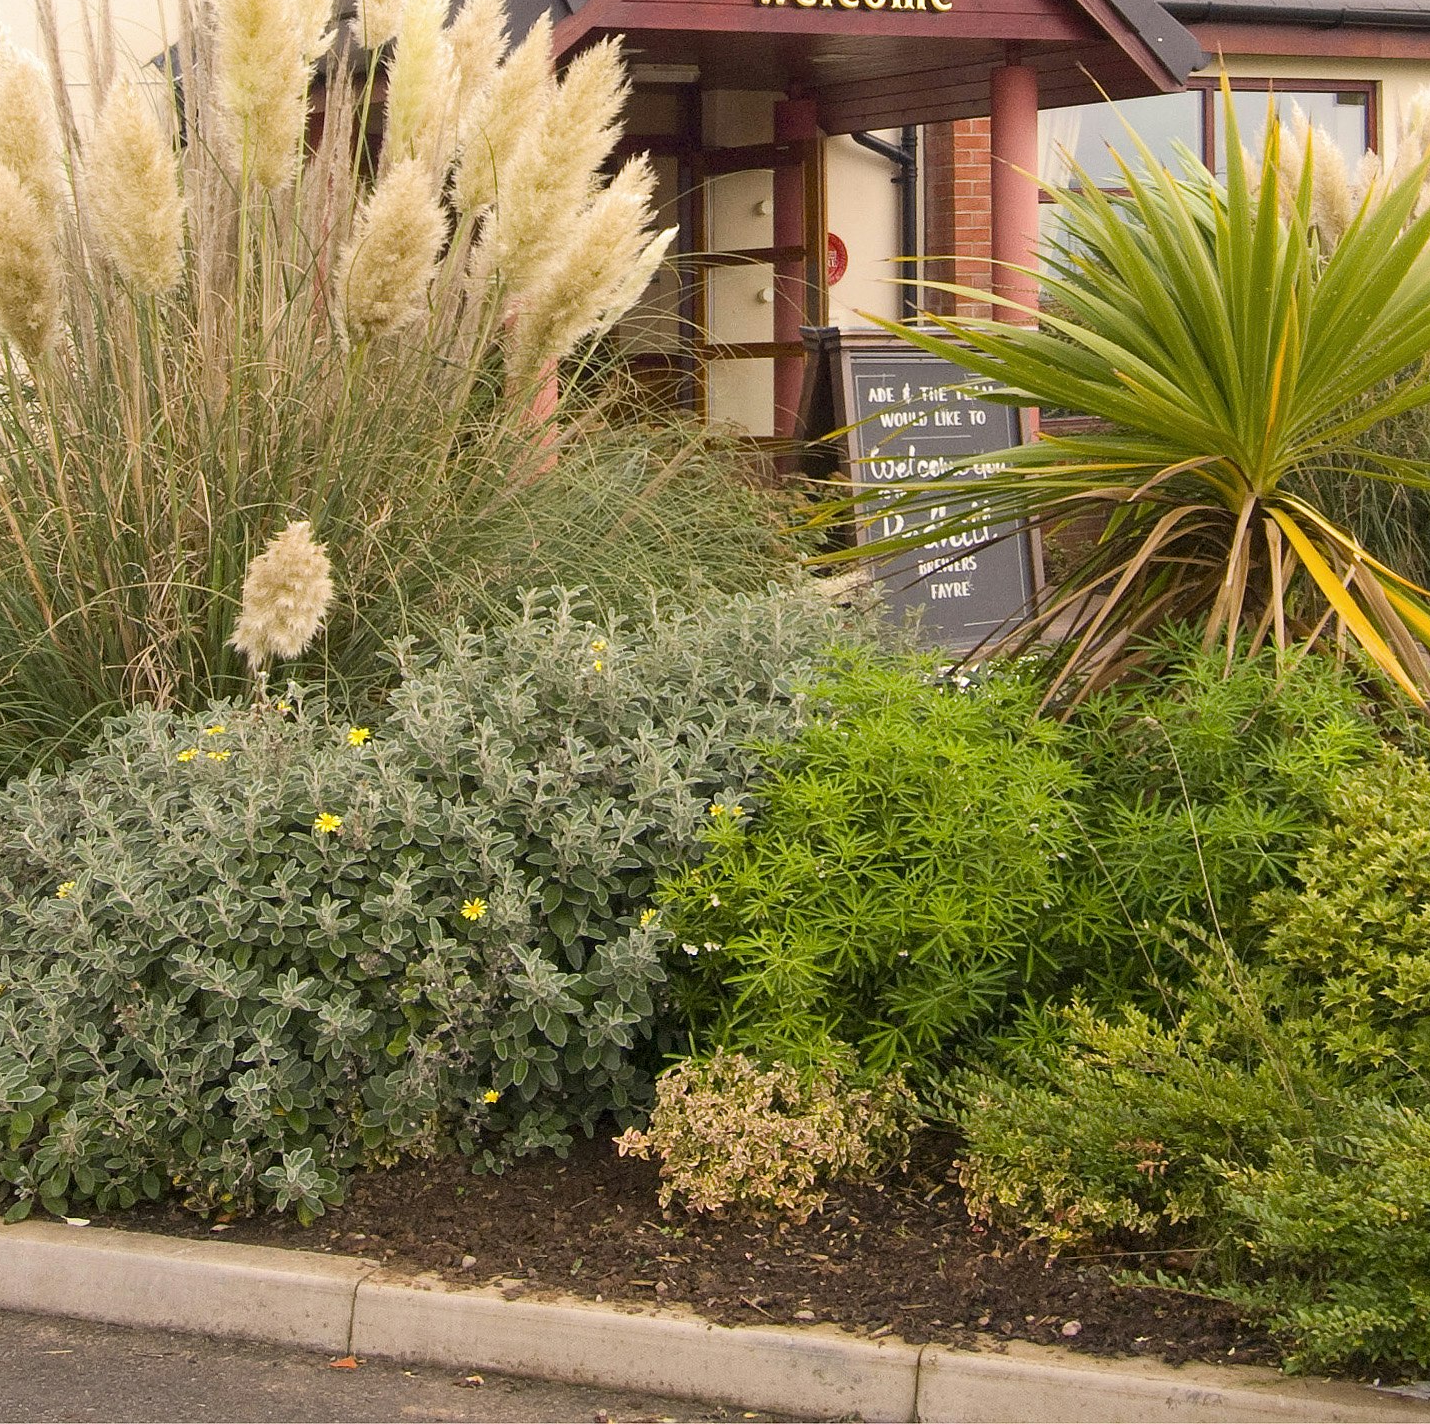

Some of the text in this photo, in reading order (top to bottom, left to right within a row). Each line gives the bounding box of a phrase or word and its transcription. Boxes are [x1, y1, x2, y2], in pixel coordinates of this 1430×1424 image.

[868, 387, 896, 403] ADE
[919, 386, 949, 402] THE
[879, 409, 987, 428] WOULD LIKE TO
[917, 555, 978, 577] BREWERS
[930, 580, 972, 600] FAYRE
